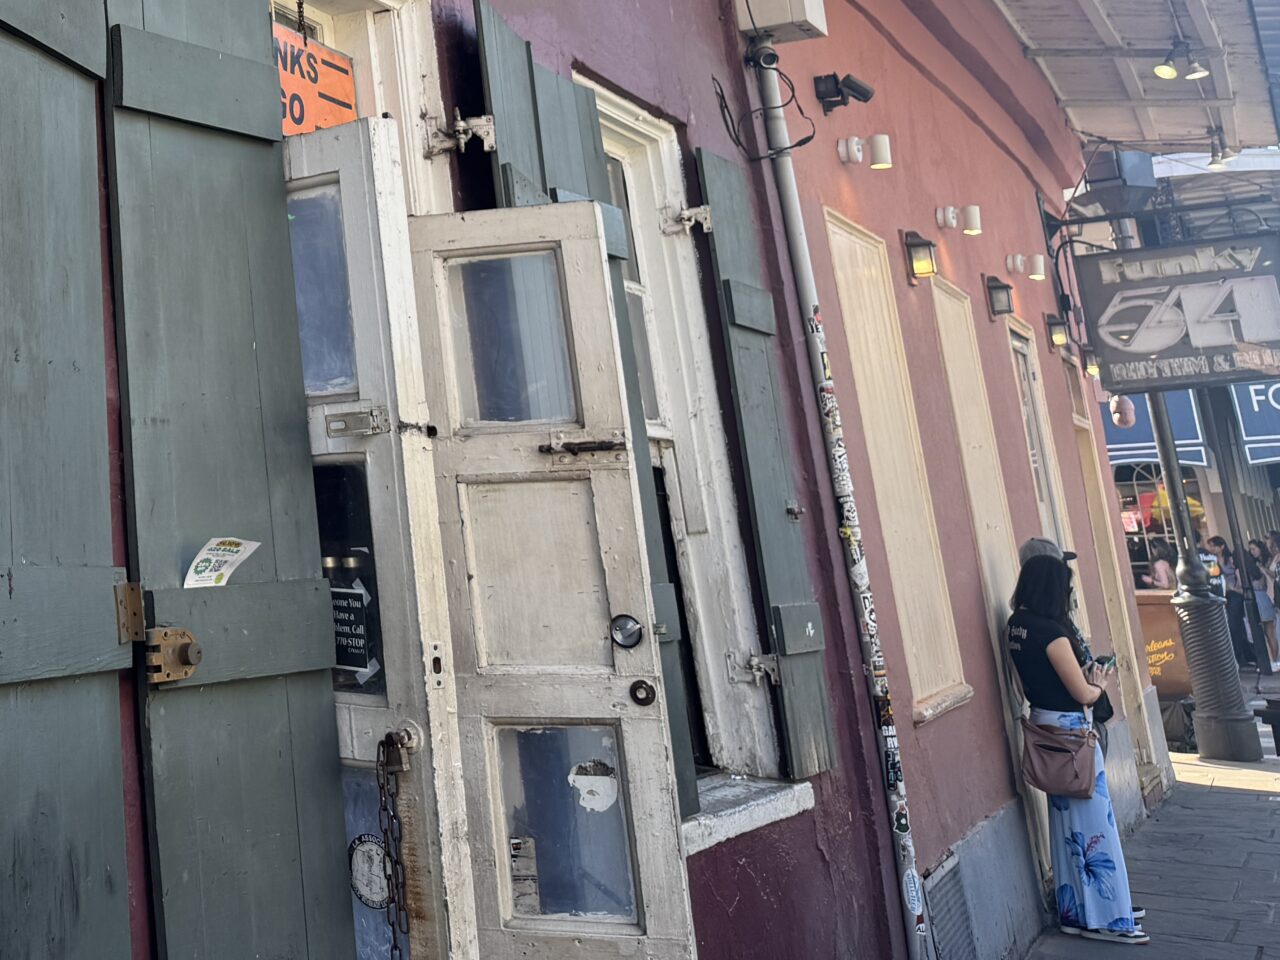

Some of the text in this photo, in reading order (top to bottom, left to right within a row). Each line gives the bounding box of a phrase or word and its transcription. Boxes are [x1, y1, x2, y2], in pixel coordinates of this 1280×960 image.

[1098, 245, 1263, 285] Funky
[1213, 353, 1230, 373] &
[348, 598, 362, 608] You
[351, 624, 365, 635] Call
